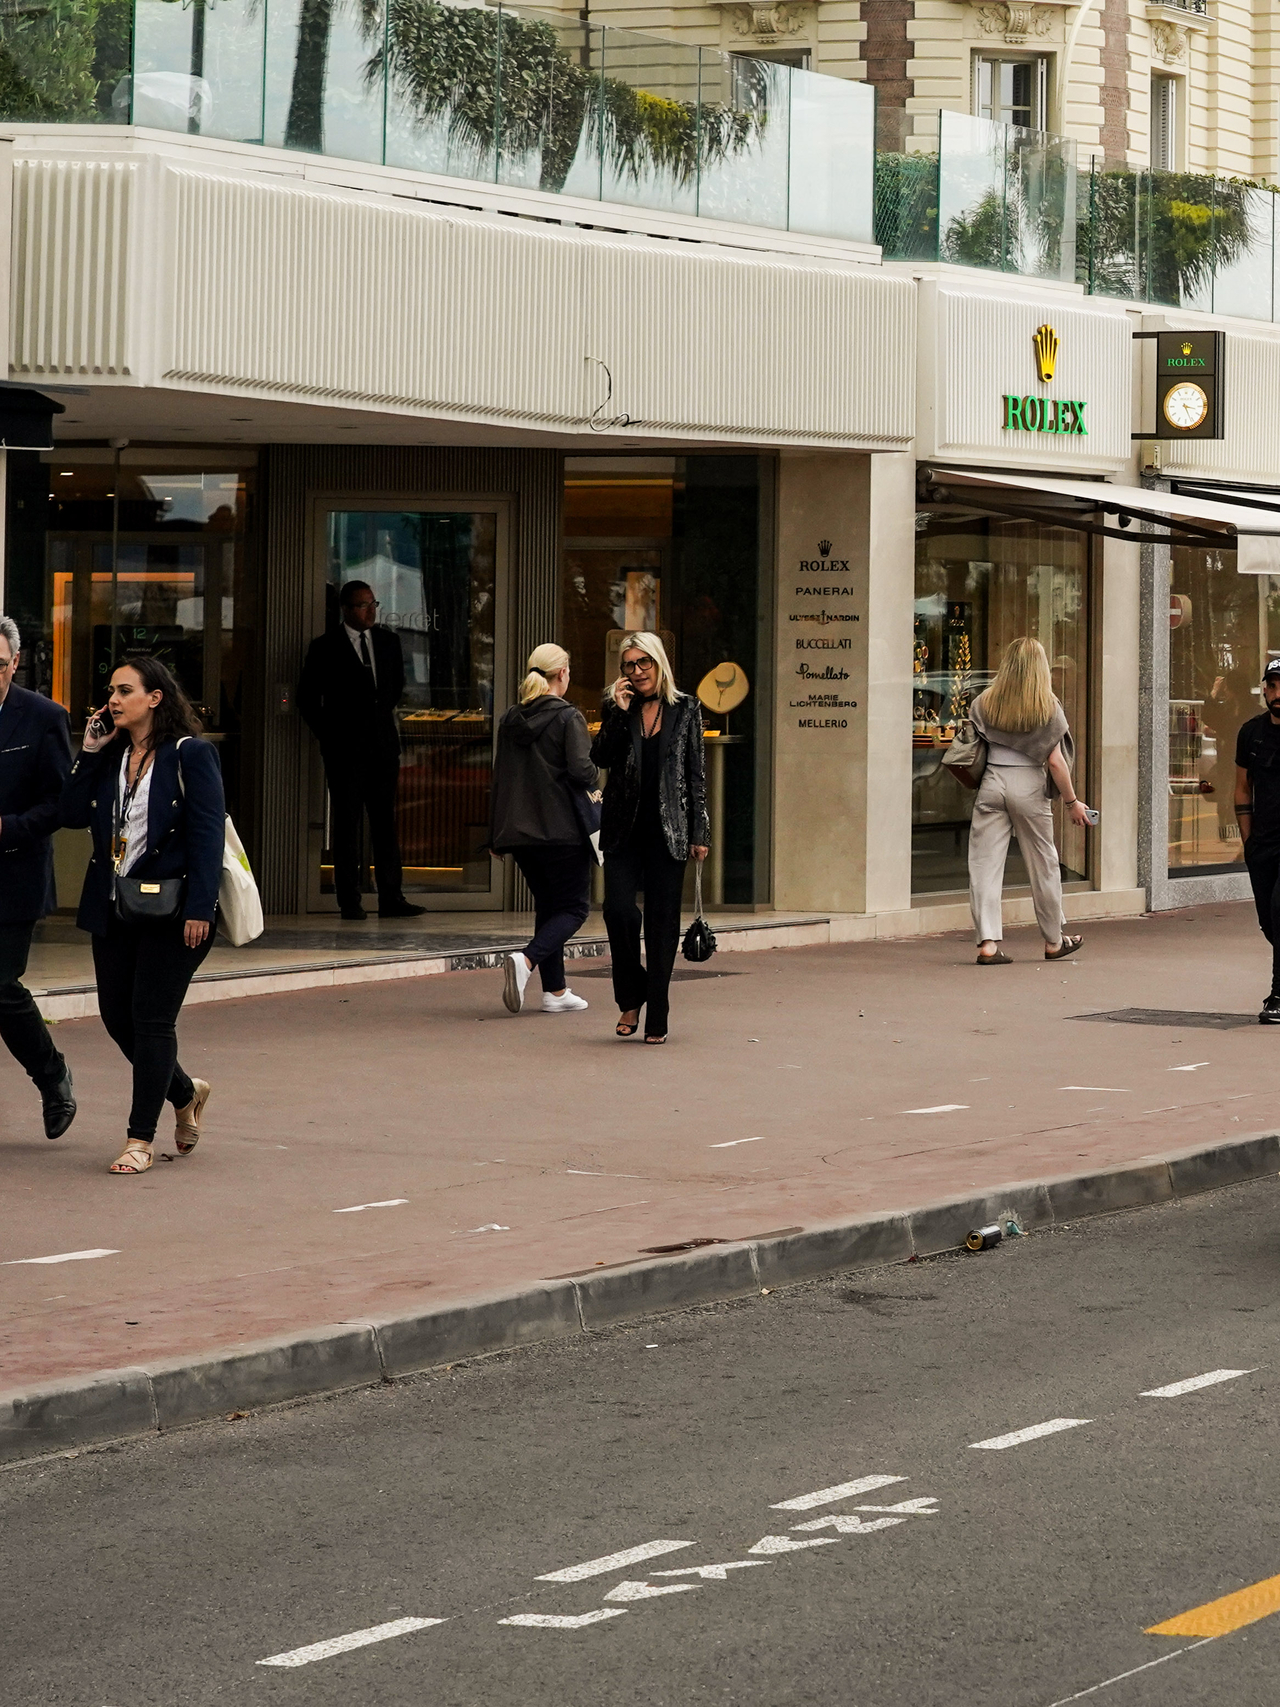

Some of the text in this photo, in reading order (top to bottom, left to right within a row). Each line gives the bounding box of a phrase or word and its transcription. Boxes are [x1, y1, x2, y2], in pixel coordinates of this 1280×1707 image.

[1167, 359, 1205, 367] ROLEX
[1003, 395, 1088, 435] ROLEX
[799, 560, 850, 572] ROLEX
[795, 587, 854, 596] PANERAI
[826, 614, 860, 622] NARDIN
[133, 627, 147, 640] 12
[796, 639, 852, 649] BUCCELLATI
[795, 662, 850, 681] Pomellato
[798, 719, 848, 729] MELLERIO
